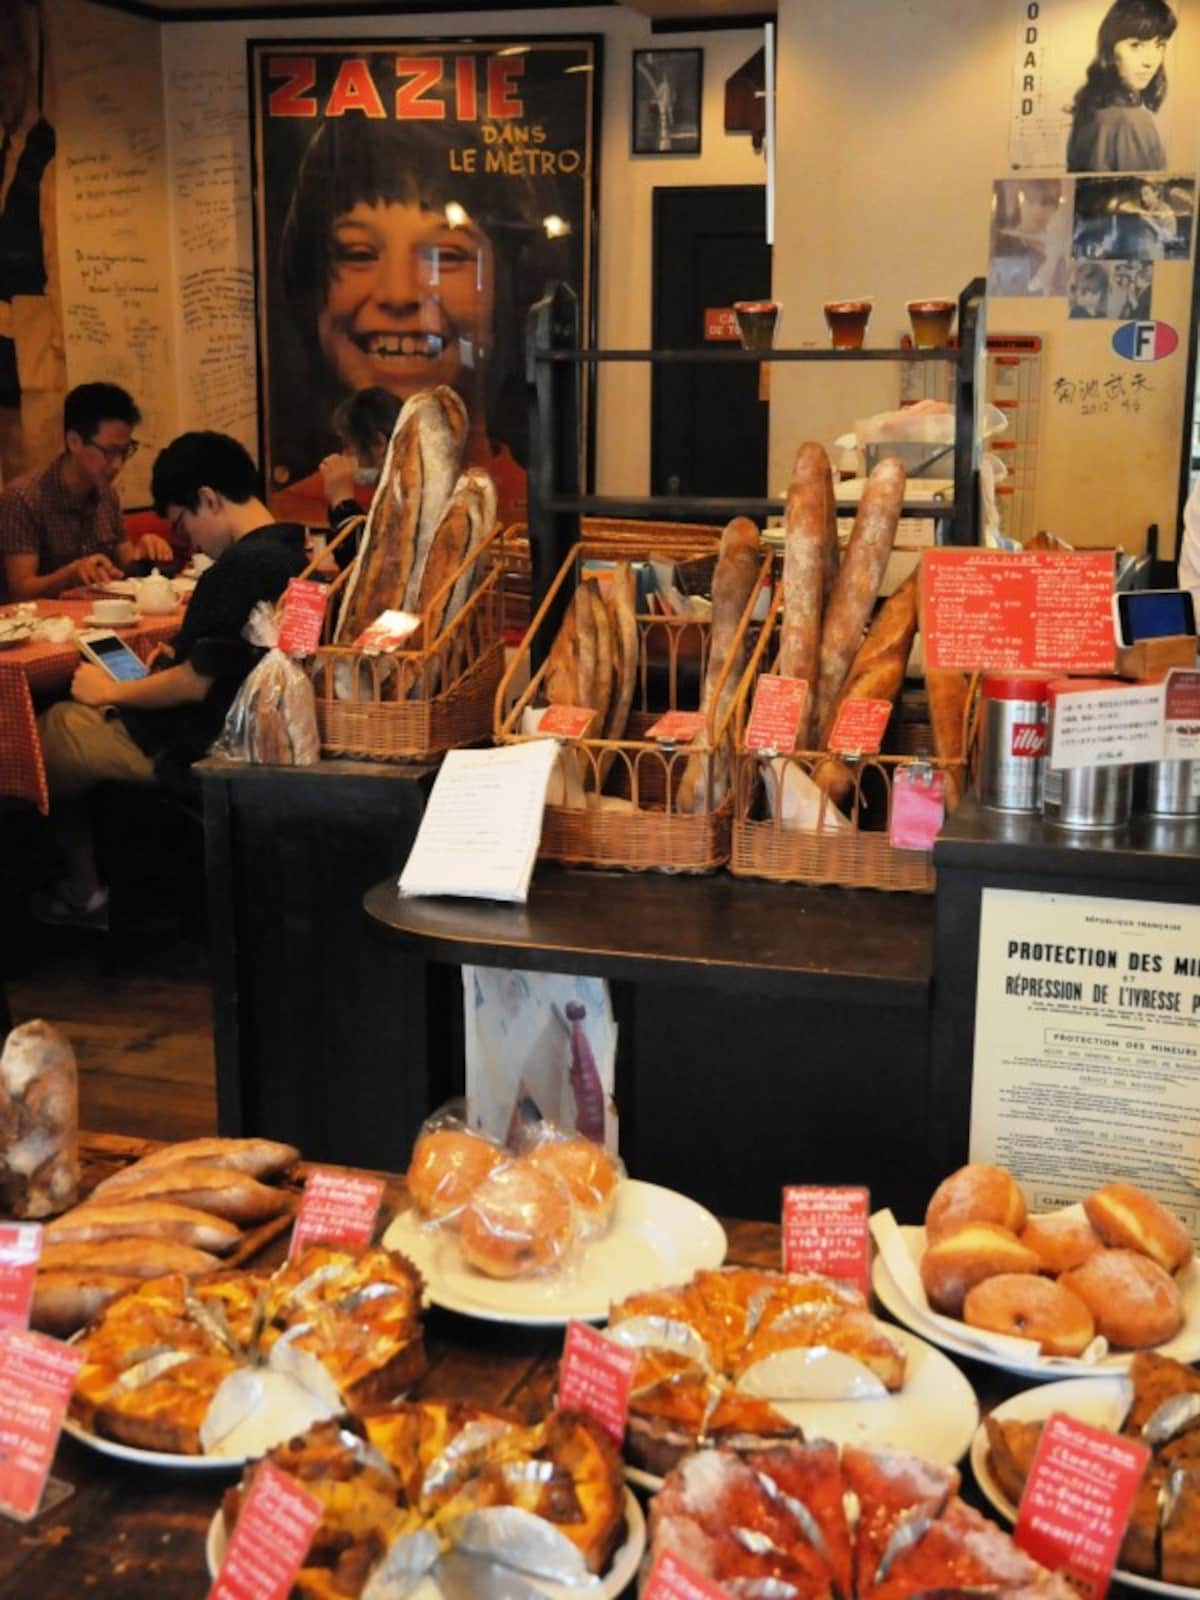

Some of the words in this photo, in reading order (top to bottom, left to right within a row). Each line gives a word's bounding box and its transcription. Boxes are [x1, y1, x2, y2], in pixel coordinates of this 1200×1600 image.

[269, 56, 524, 120] ZAZIE
[481, 126, 546, 145] DANS
[450, 149, 476, 172] LE
[1136, 325, 1154, 357] F
[1013, 729, 1044, 753] illy
[1008, 941, 1117, 968] PROTECTION
[1128, 952, 1162, 972] DES
[1005, 973, 1082, 1000] RÉPRESSION
[1093, 984, 1108, 1004] DE
[1119, 987, 1181, 1012] L'IVRESSE
[1053, 1033, 1119, 1047] PROTECTION
[1126, 1040, 1145, 1050] DES
[1151, 1043, 1197, 1057] MINEURS
